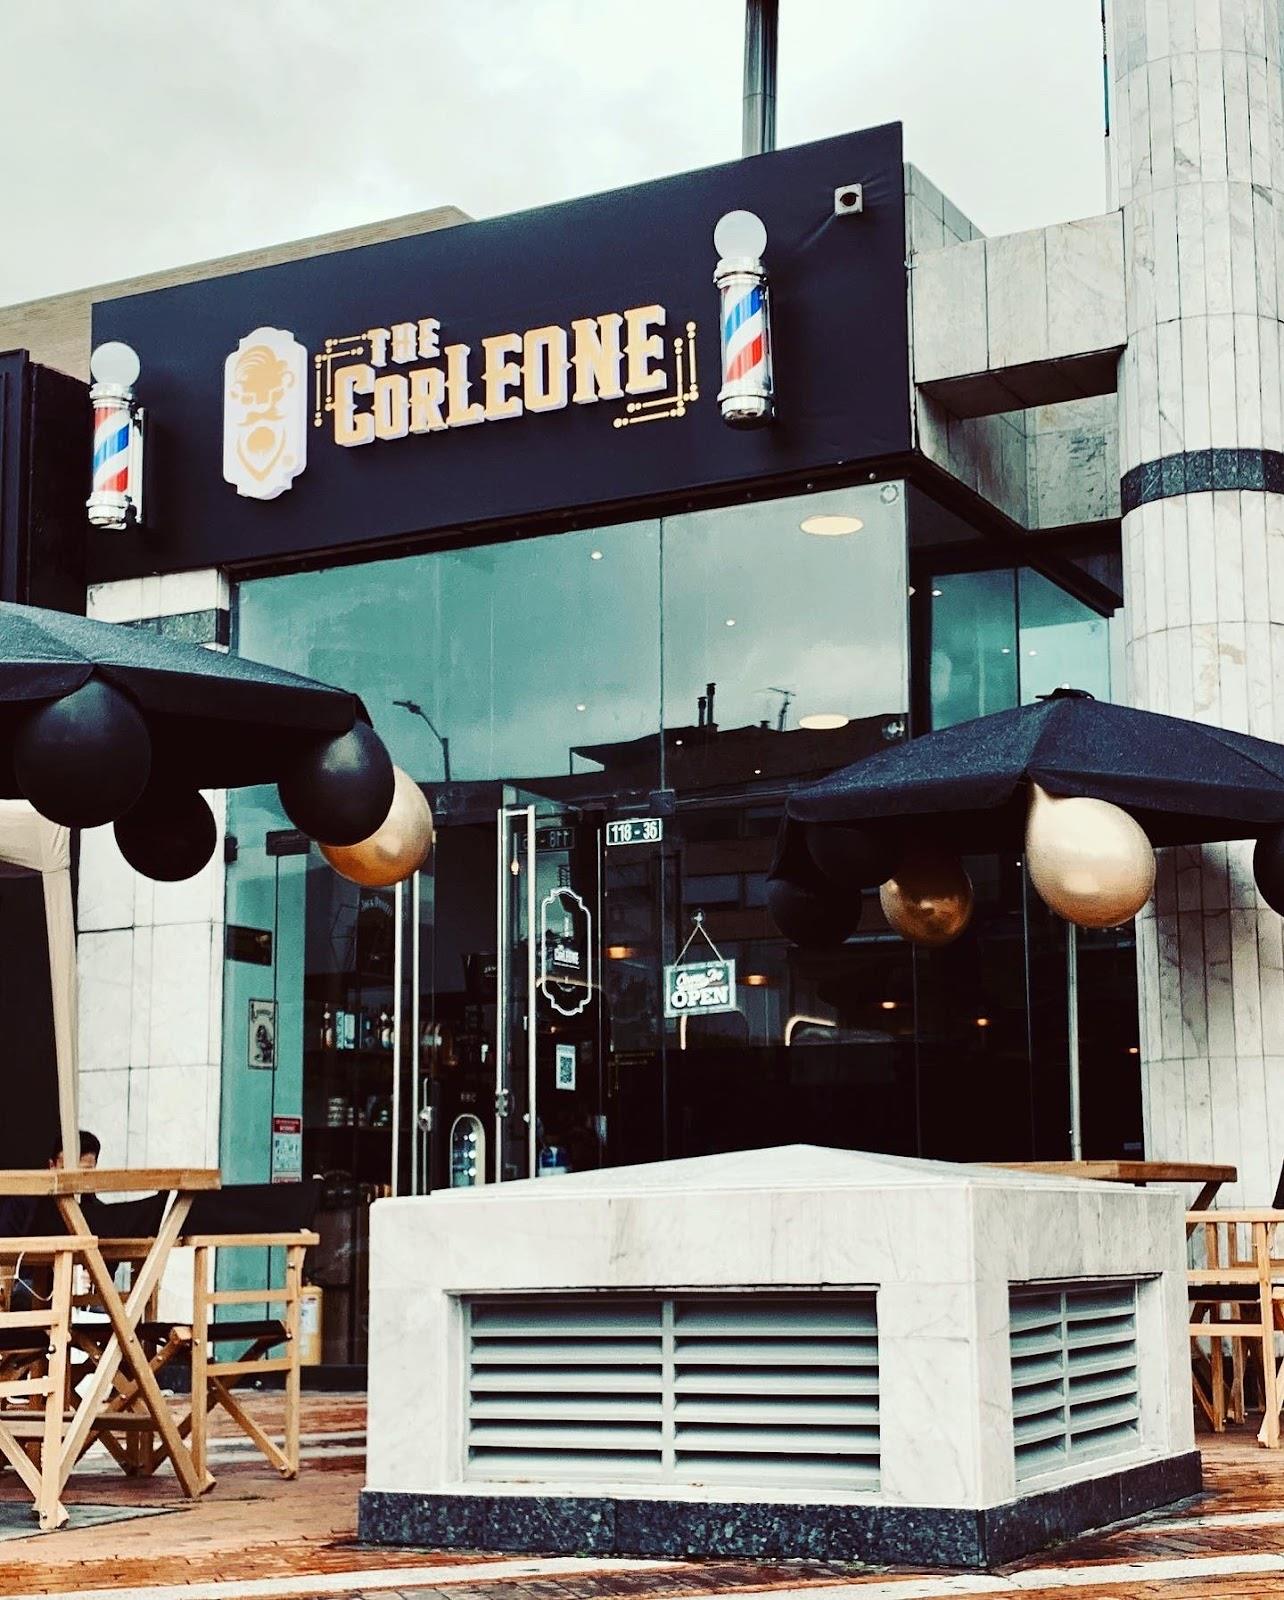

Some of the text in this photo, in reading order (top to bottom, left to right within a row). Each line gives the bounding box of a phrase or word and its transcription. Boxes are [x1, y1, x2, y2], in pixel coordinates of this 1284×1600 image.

[368, 317, 441, 368] THE
[334, 303, 667, 448] CORLEONE
[611, 824, 633, 842] 118
[642, 821, 658, 839] 36
[671, 985, 729, 1009] OPEN
